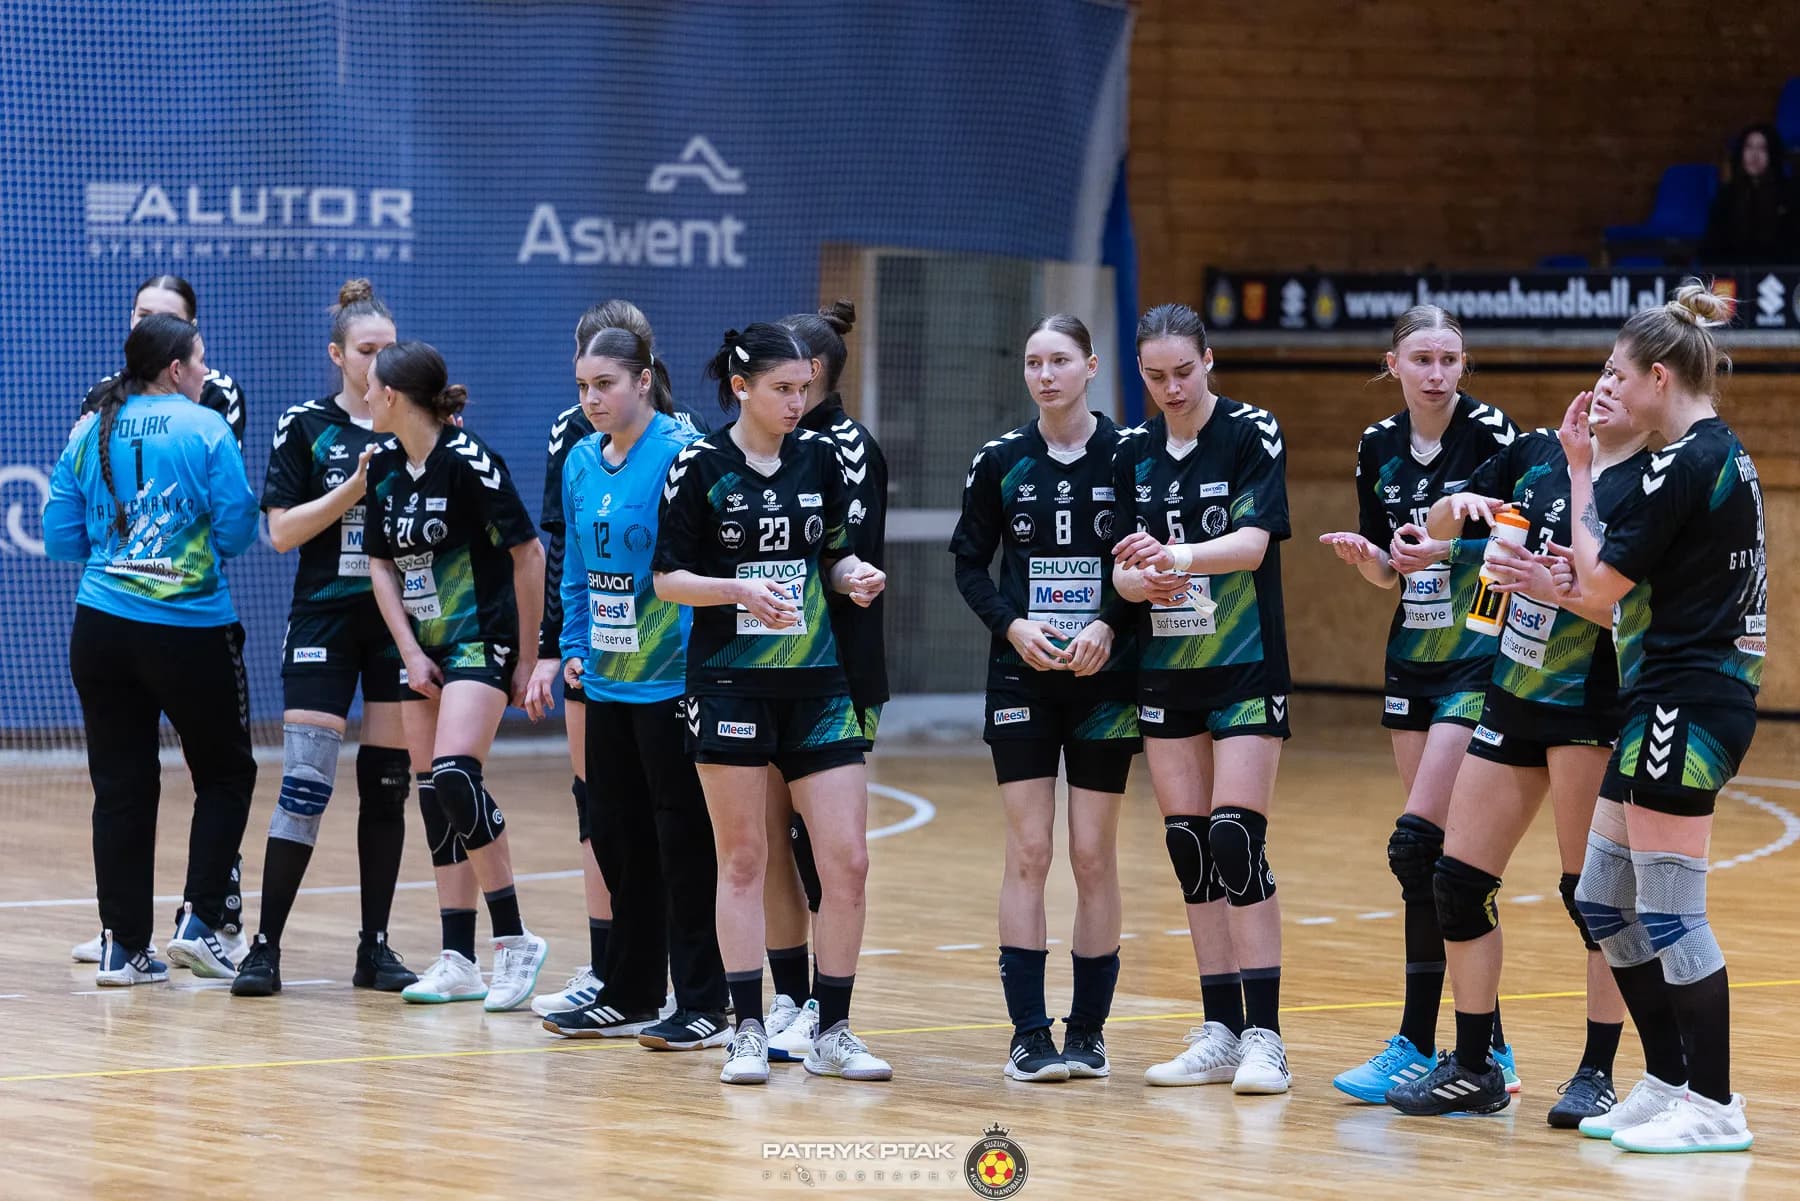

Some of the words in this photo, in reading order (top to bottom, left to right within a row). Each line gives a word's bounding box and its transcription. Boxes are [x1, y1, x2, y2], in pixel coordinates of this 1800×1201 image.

[131, 185, 414, 227] ALUTOR
[517, 203, 747, 267] Aswent
[1344, 277, 1665, 319] wwwkoronahandball.pl
[130, 439, 145, 492] 1
[397, 517, 416, 548] 21
[593, 521, 612, 559] 12
[759, 516, 790, 552] 23
[1056, 510, 1072, 545] 8
[1166, 510, 1185, 544] 6
[591, 600, 627, 619] Meest
[1035, 586, 1091, 603] Meest
[1156, 617, 1208, 629] softserve
[1511, 600, 1541, 631] Meest
[592, 631, 633, 645] softserve
[296, 650, 322, 659] Meest
[720, 723, 754, 735] Meest
[995, 711, 1027, 722] Meest
